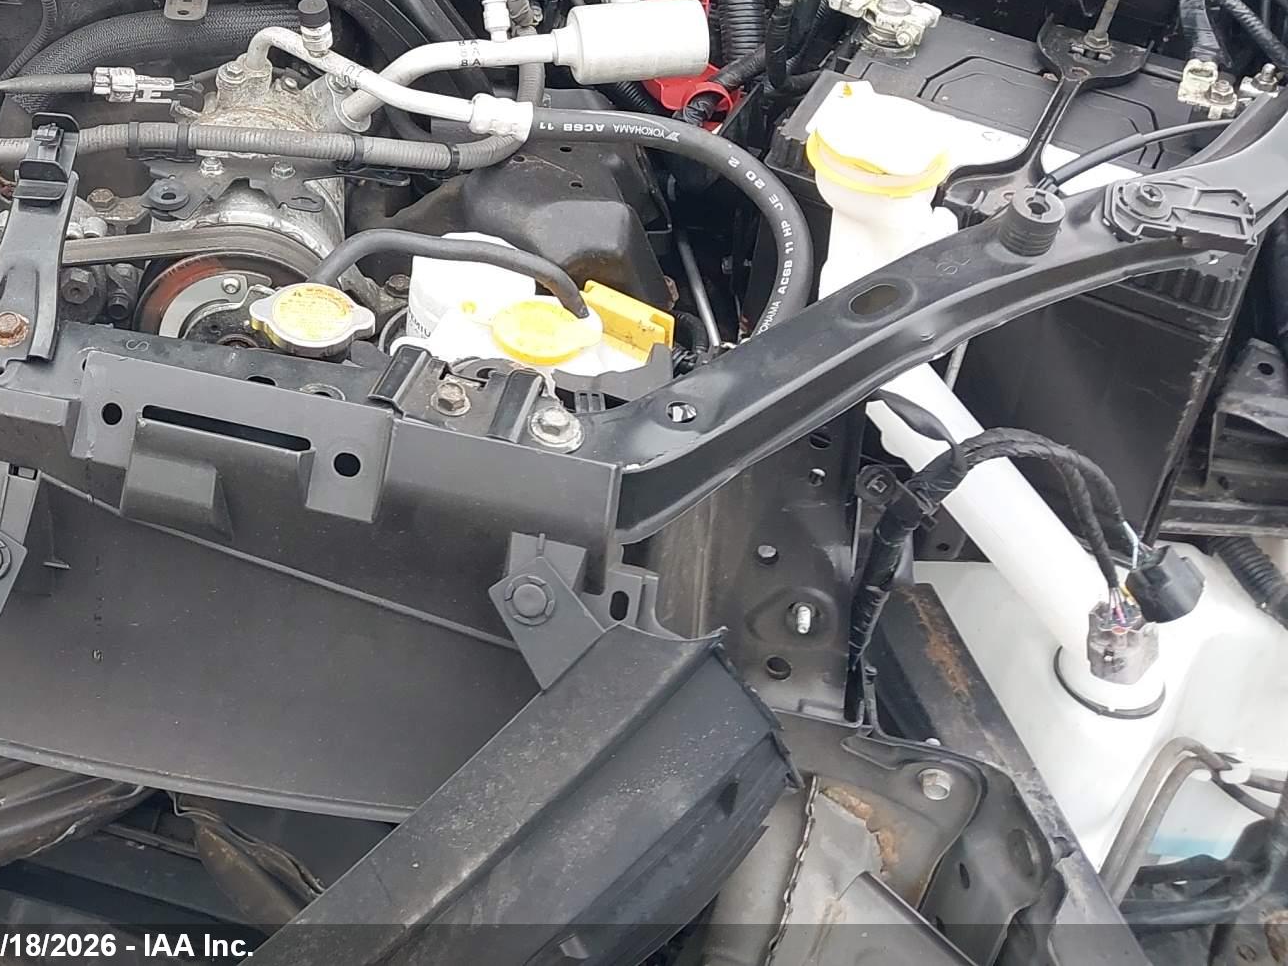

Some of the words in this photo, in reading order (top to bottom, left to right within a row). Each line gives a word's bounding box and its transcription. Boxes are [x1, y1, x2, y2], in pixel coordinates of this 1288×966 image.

[612, 123, 665, 138] YOKOHAMA
[745, 171, 766, 190] 20
[768, 194, 784, 211] JE
[780, 219, 793, 238] HP
[784, 241, 794, 255] 11
